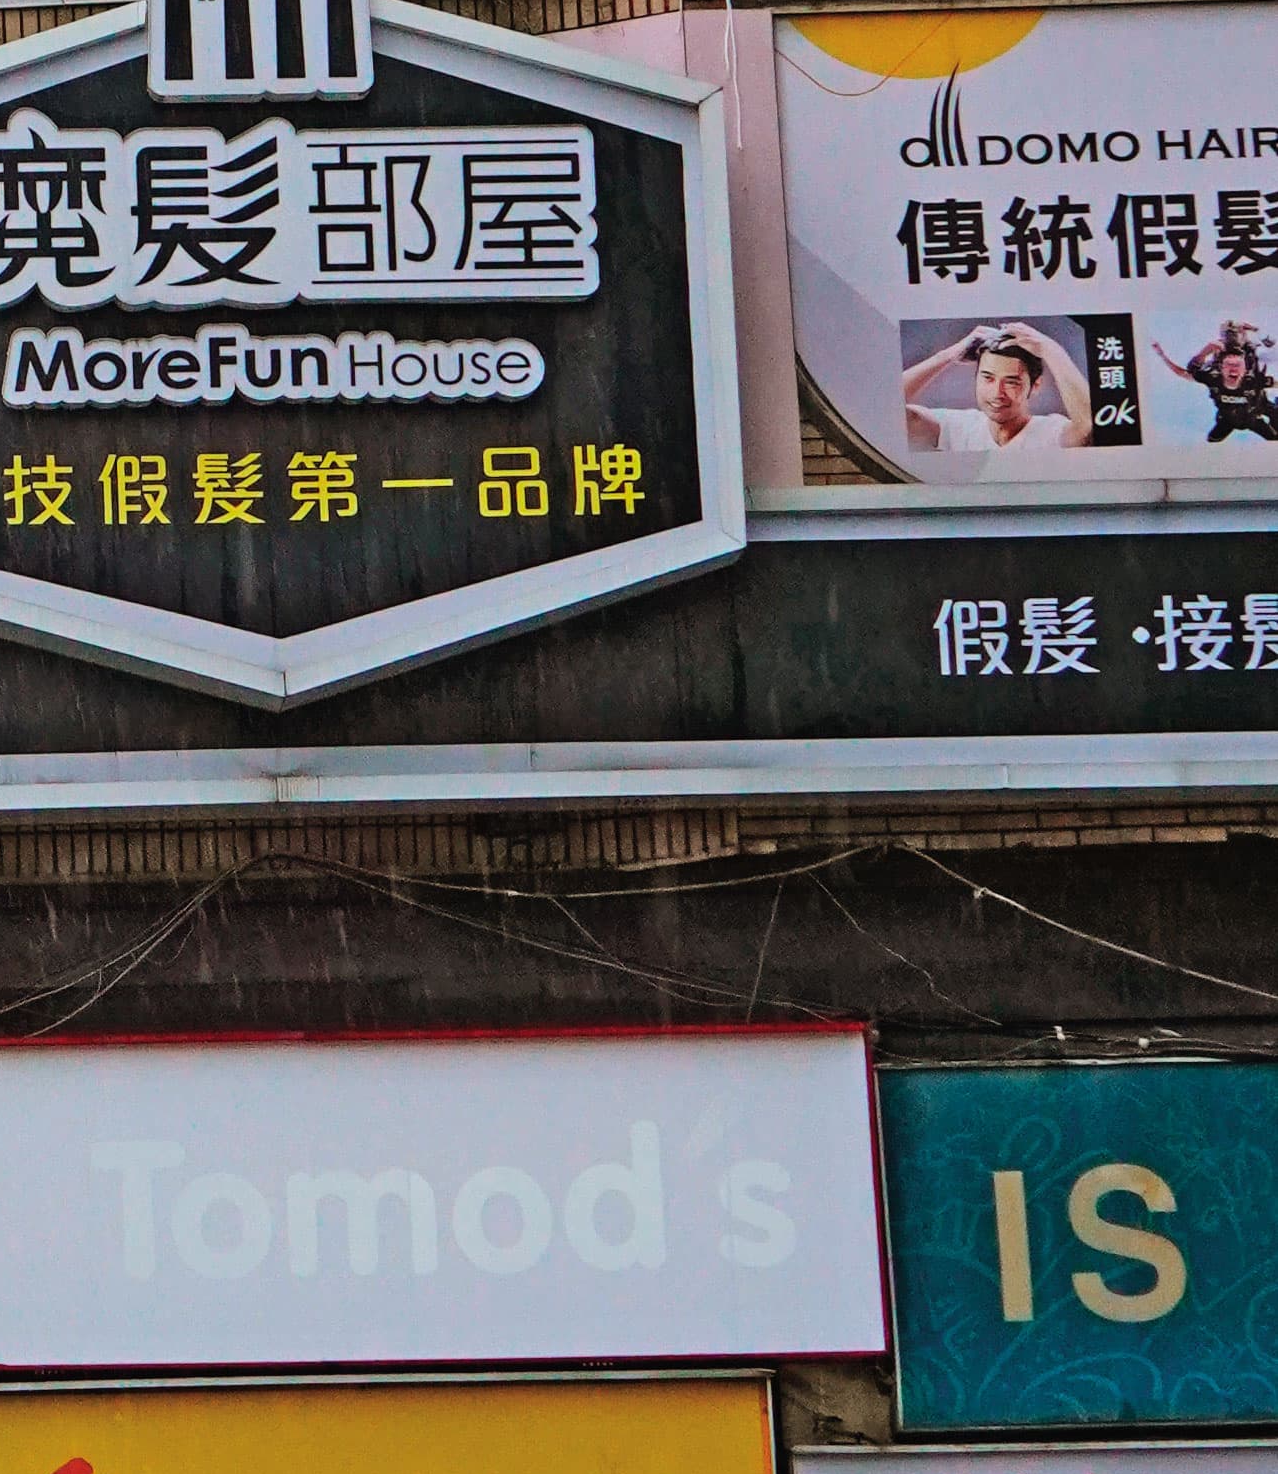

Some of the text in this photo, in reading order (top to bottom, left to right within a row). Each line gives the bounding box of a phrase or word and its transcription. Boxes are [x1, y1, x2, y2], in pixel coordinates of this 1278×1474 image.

[977, 129, 1141, 166] DOMO
[348, 338, 534, 388] House
[1095, 336, 1128, 391] 洗頭
[92, 1104, 798, 1284] Tomod's
[992, 1163, 1188, 1323] IS
